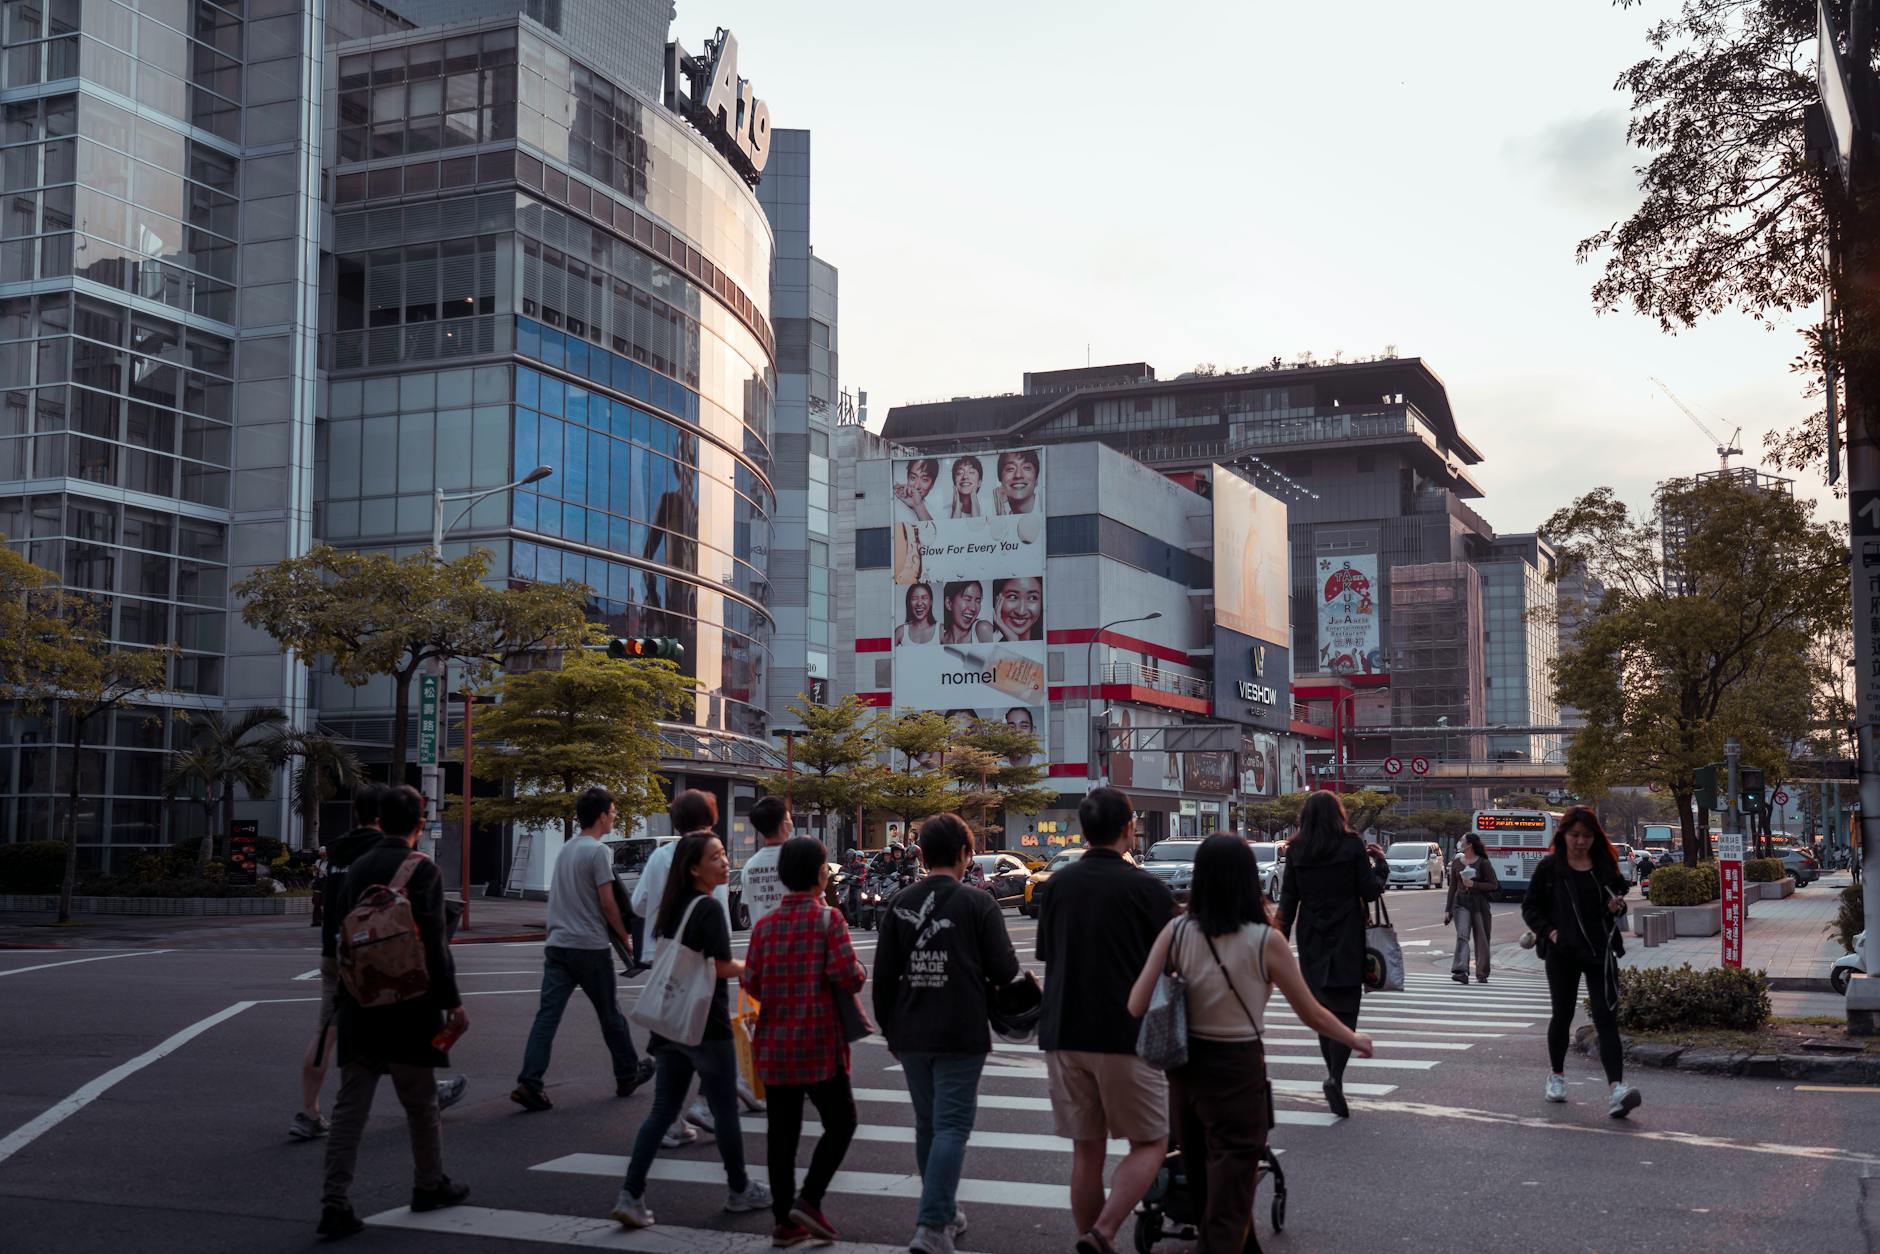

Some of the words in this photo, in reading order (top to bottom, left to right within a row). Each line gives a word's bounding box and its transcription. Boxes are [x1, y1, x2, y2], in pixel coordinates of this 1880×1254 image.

[703, 30, 771, 172] A19
[947, 543, 965, 555] For
[967, 542, 997, 554] Every
[1000, 541, 1019, 551] You
[1343, 562, 1352, 624] SAKURA
[941, 668, 996, 685] nomel
[1238, 680, 1277, 706] VIESHOW
[1037, 821, 1068, 833] NEW
[1020, 834, 1081, 847] BALANCE
[911, 962, 945, 973] MADE
